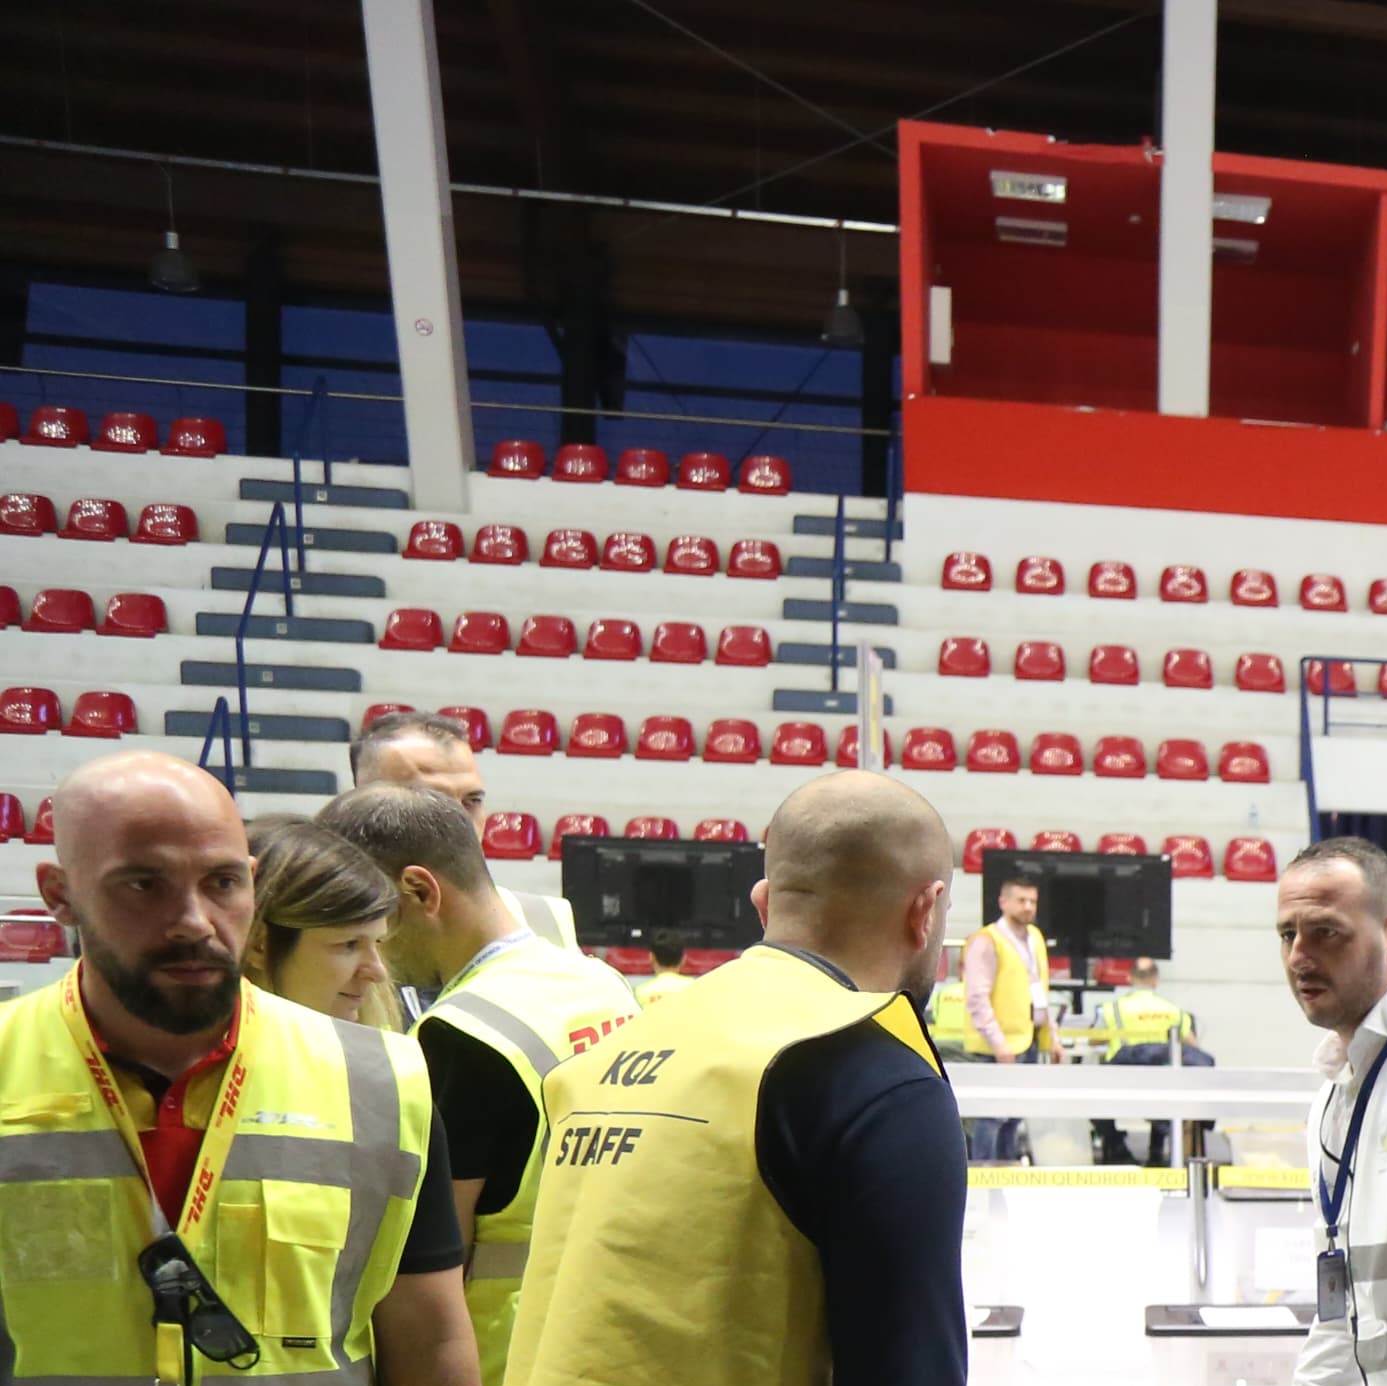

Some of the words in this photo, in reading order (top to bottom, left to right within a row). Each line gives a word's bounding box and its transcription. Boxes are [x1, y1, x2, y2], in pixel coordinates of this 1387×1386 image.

[219, 1064, 248, 1120] DHL
[598, 1049, 676, 1087] KQZ
[555, 1126, 643, 1167] STAFF
[186, 1170, 214, 1225] DHL
